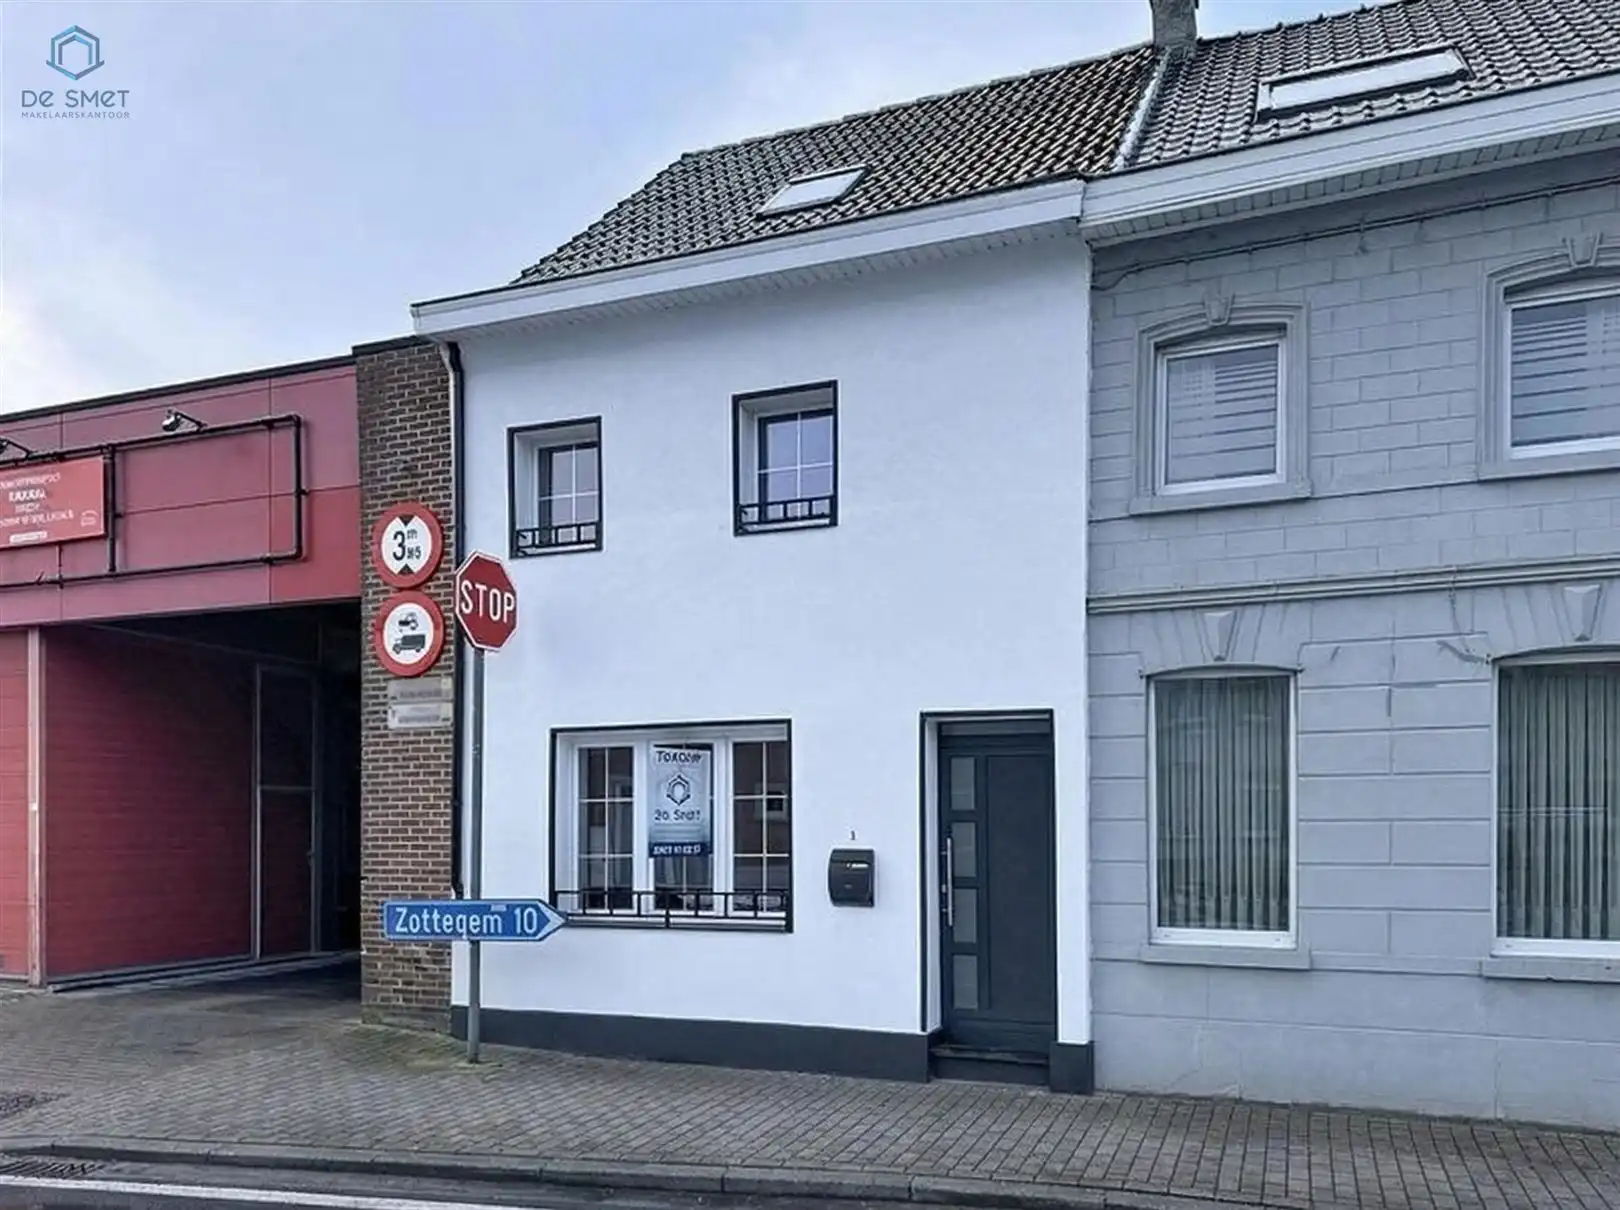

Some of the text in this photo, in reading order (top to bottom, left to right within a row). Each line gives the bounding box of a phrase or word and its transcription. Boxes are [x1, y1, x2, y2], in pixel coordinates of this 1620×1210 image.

[393, 530, 406, 560] 3
[460, 580, 515, 624] STOP
[395, 907, 538, 939] Zottegem 10
